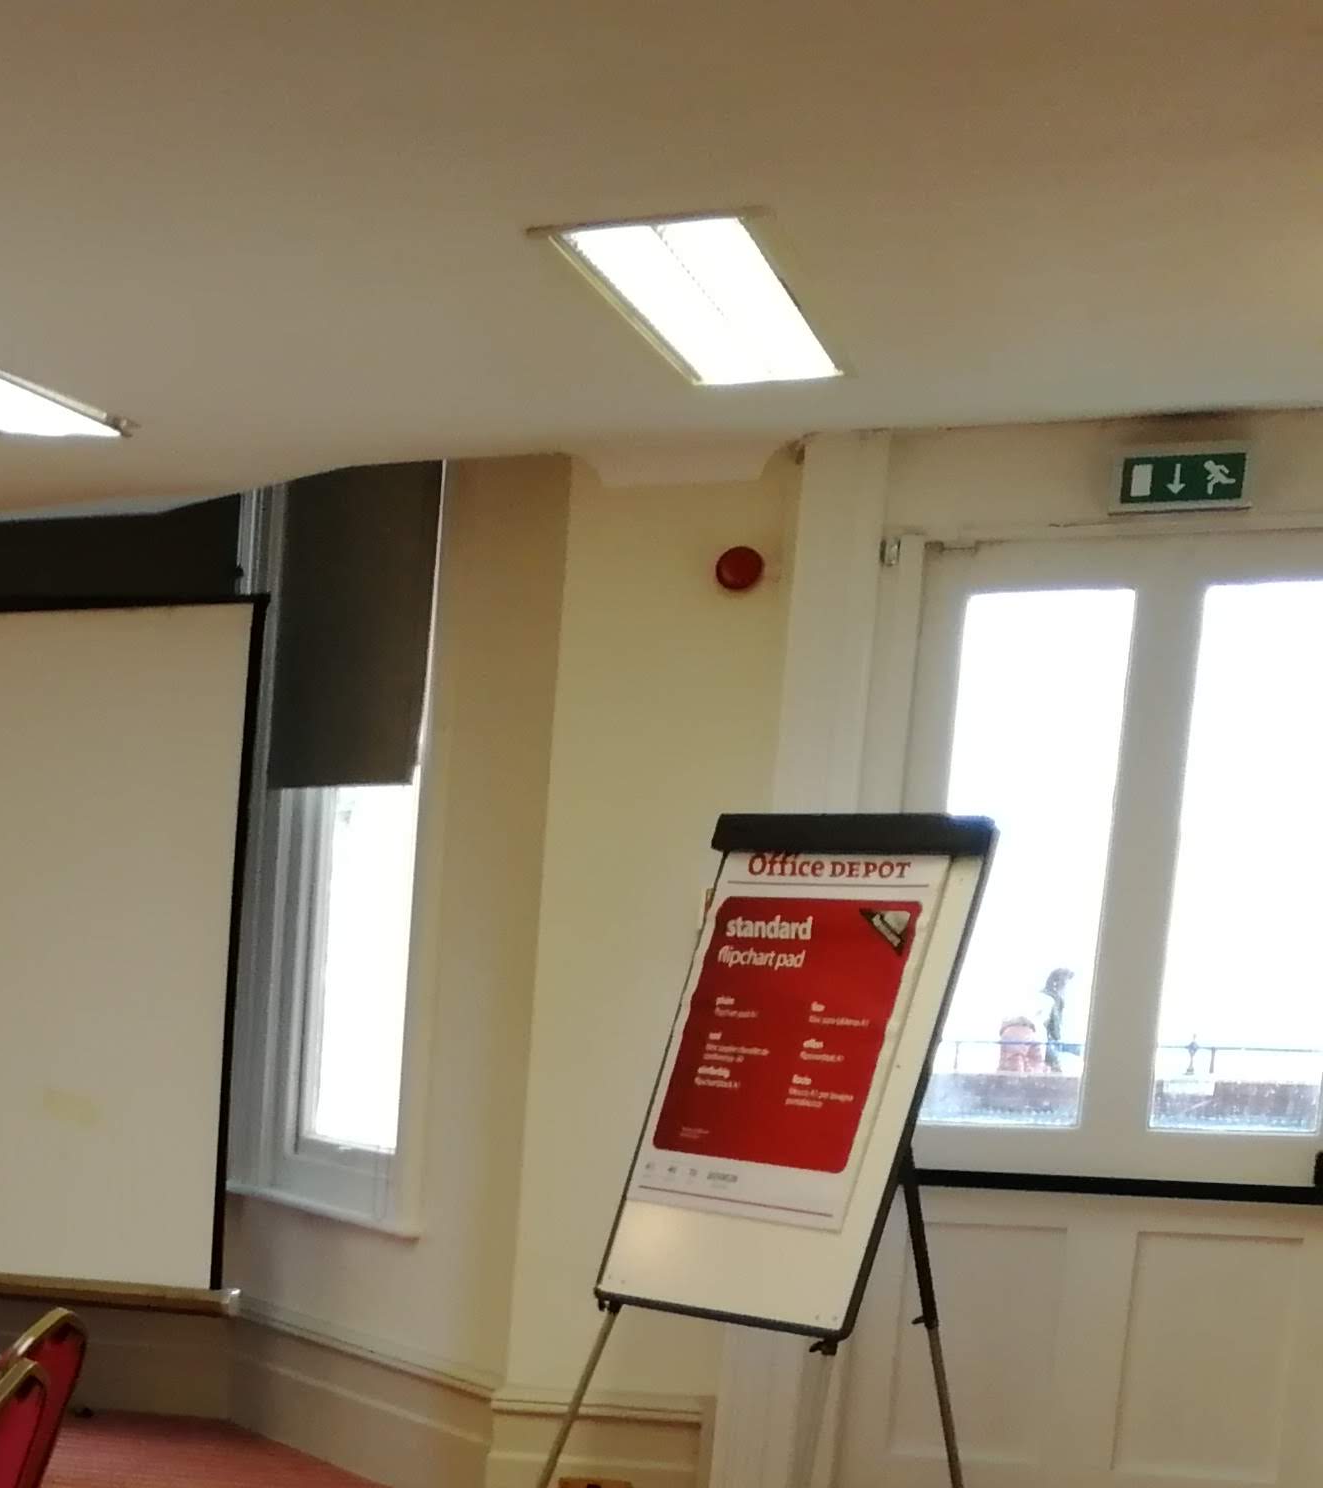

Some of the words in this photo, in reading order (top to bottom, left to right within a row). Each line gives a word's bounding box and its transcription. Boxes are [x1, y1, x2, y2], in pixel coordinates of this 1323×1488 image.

[748, 853, 824, 877] Office
[829, 861, 911, 878] DEPOT
[726, 914, 813, 940] standard
[718, 946, 775, 968] flipchart
[775, 950, 805, 970] pad
